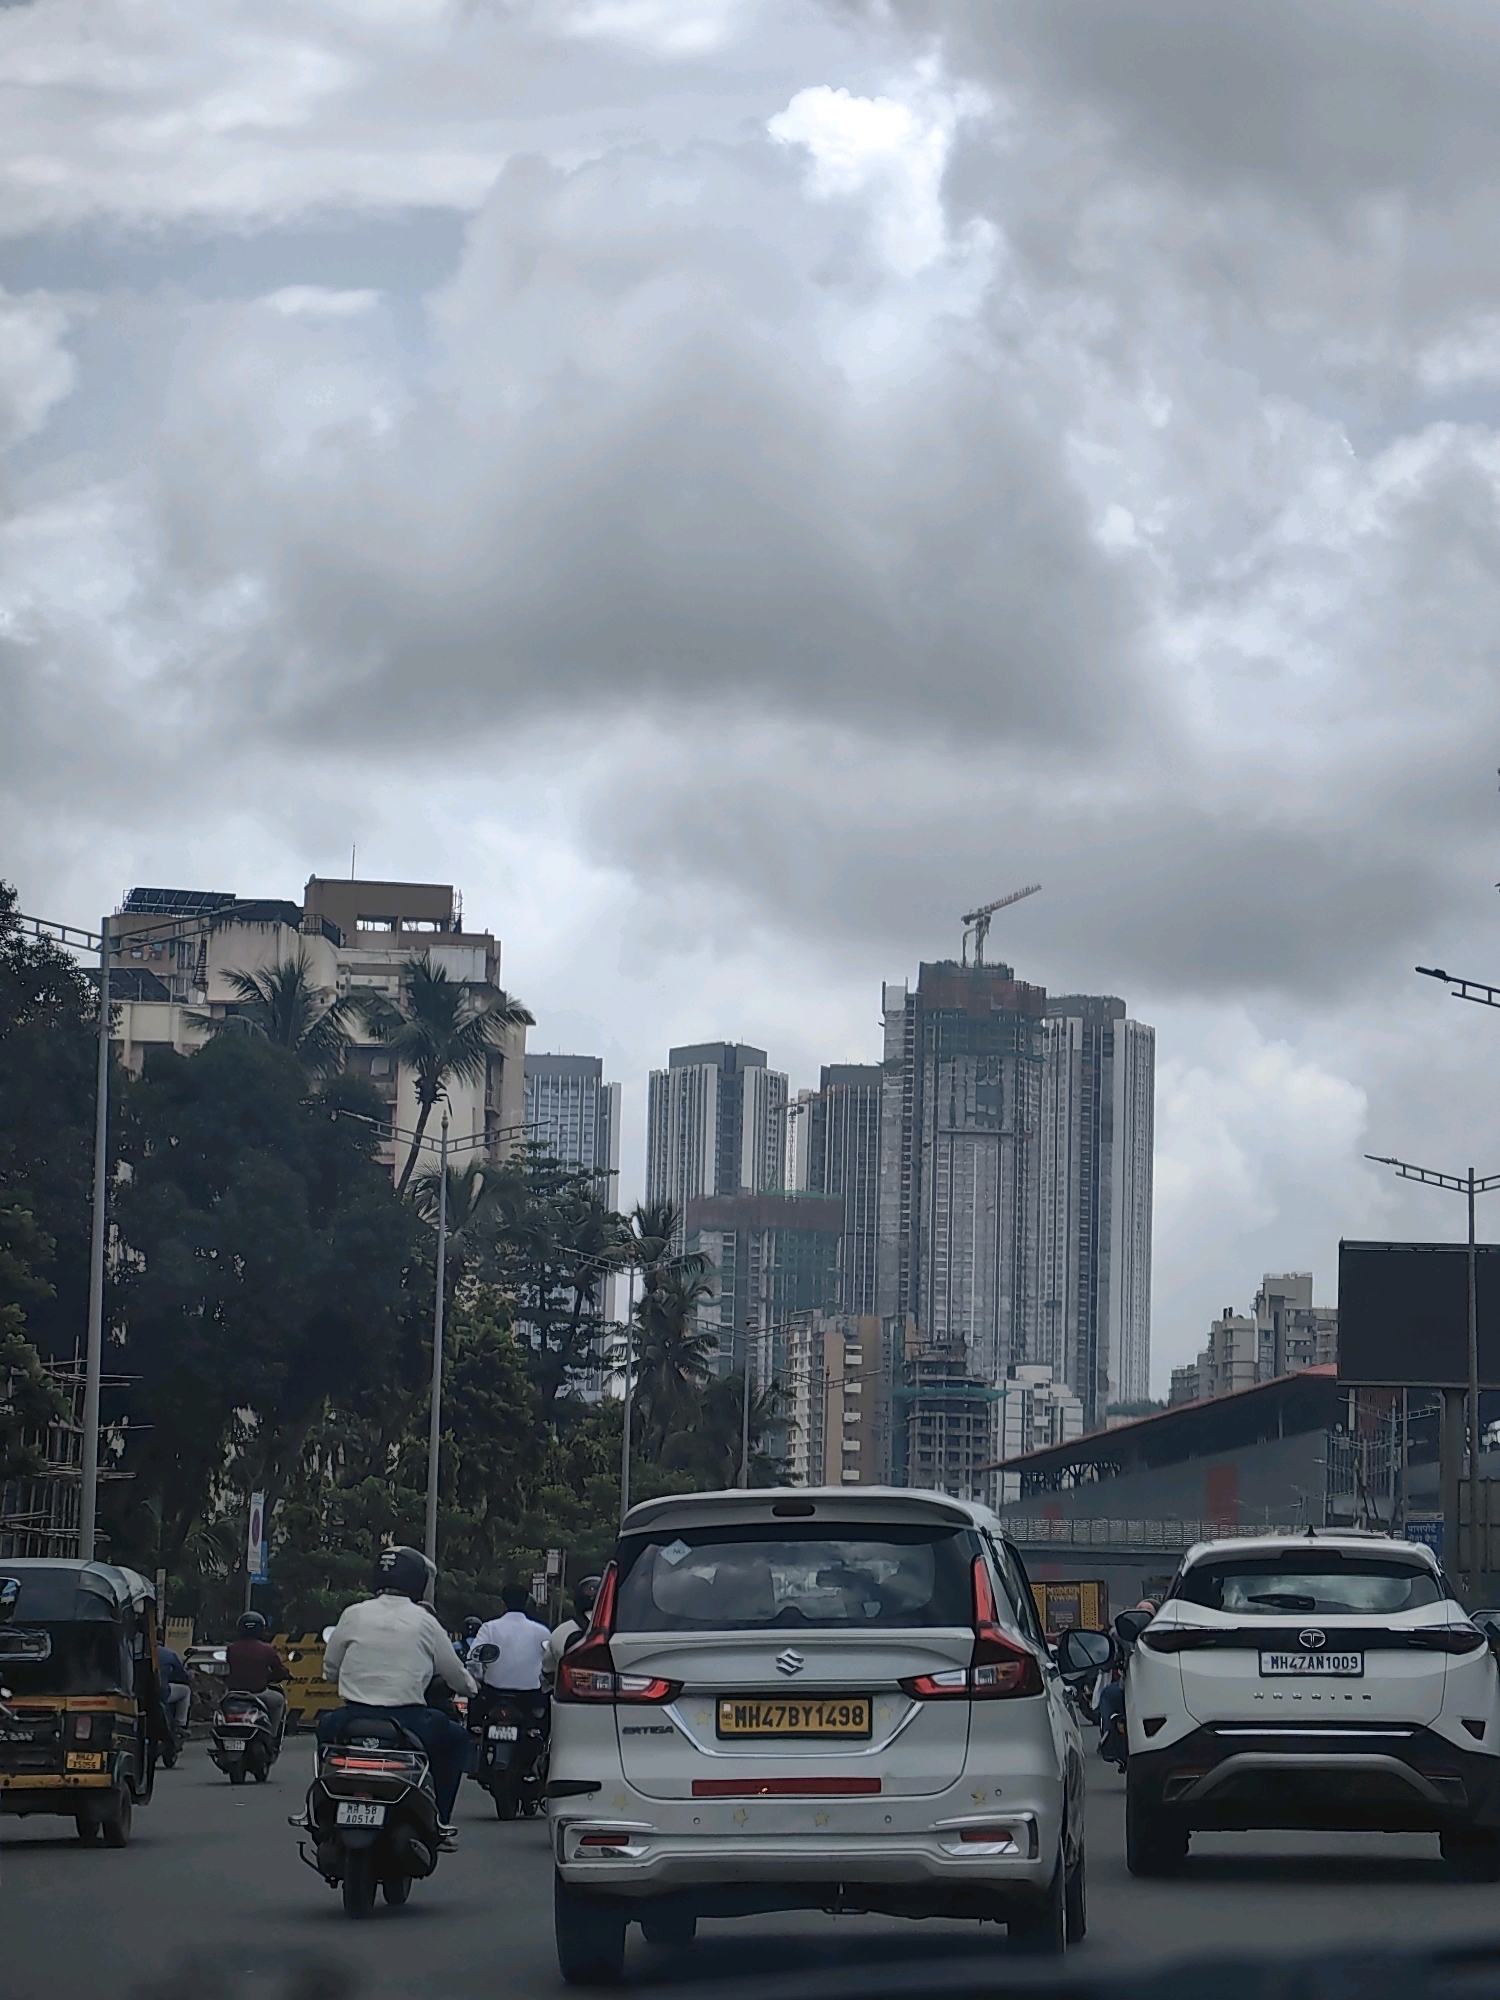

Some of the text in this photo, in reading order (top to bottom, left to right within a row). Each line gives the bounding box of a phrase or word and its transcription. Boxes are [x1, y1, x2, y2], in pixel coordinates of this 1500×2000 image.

[1046, 1586, 1080, 1595] MODERN
[1270, 1655, 1358, 1670] MH47AN1009
[734, 1705, 864, 1729] MH47BY1498
[622, 1725, 675, 1735] ERTIGA
[346, 1814, 375, 1824] A0514
